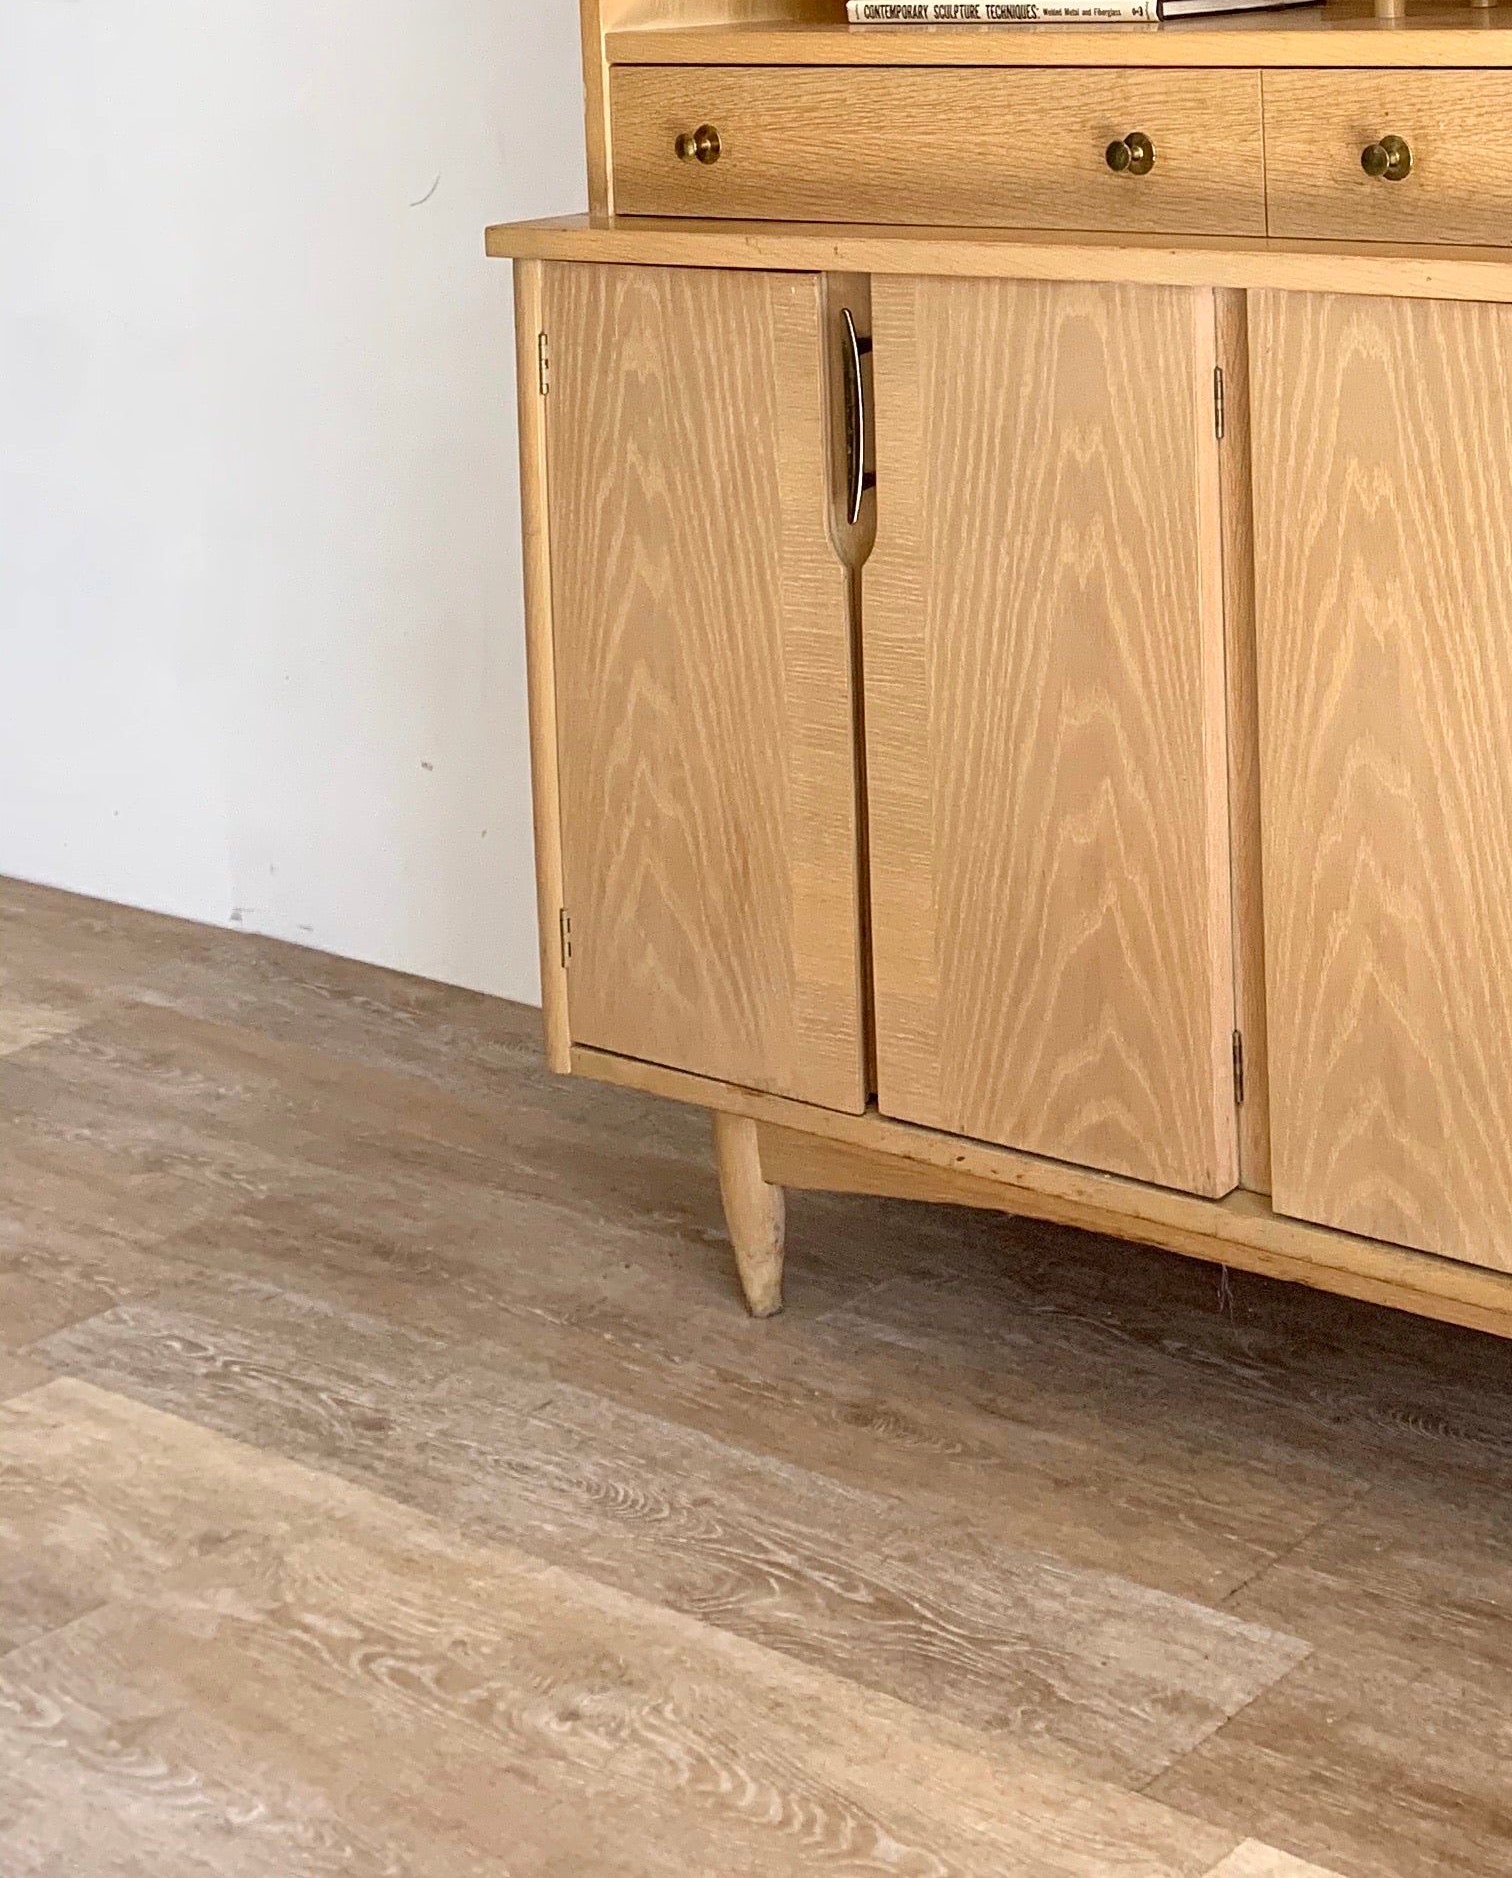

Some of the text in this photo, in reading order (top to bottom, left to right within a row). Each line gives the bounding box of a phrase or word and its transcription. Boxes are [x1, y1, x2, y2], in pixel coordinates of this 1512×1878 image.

[864, 4, 929, 20] CONTEMPORARY
[933, 4, 981, 20] SCULPTURE
[985, 4, 1041, 20] TECHNIQUES:
[1064, 7, 1079, 16] Metal
[1082, 8, 1091, 16] and
